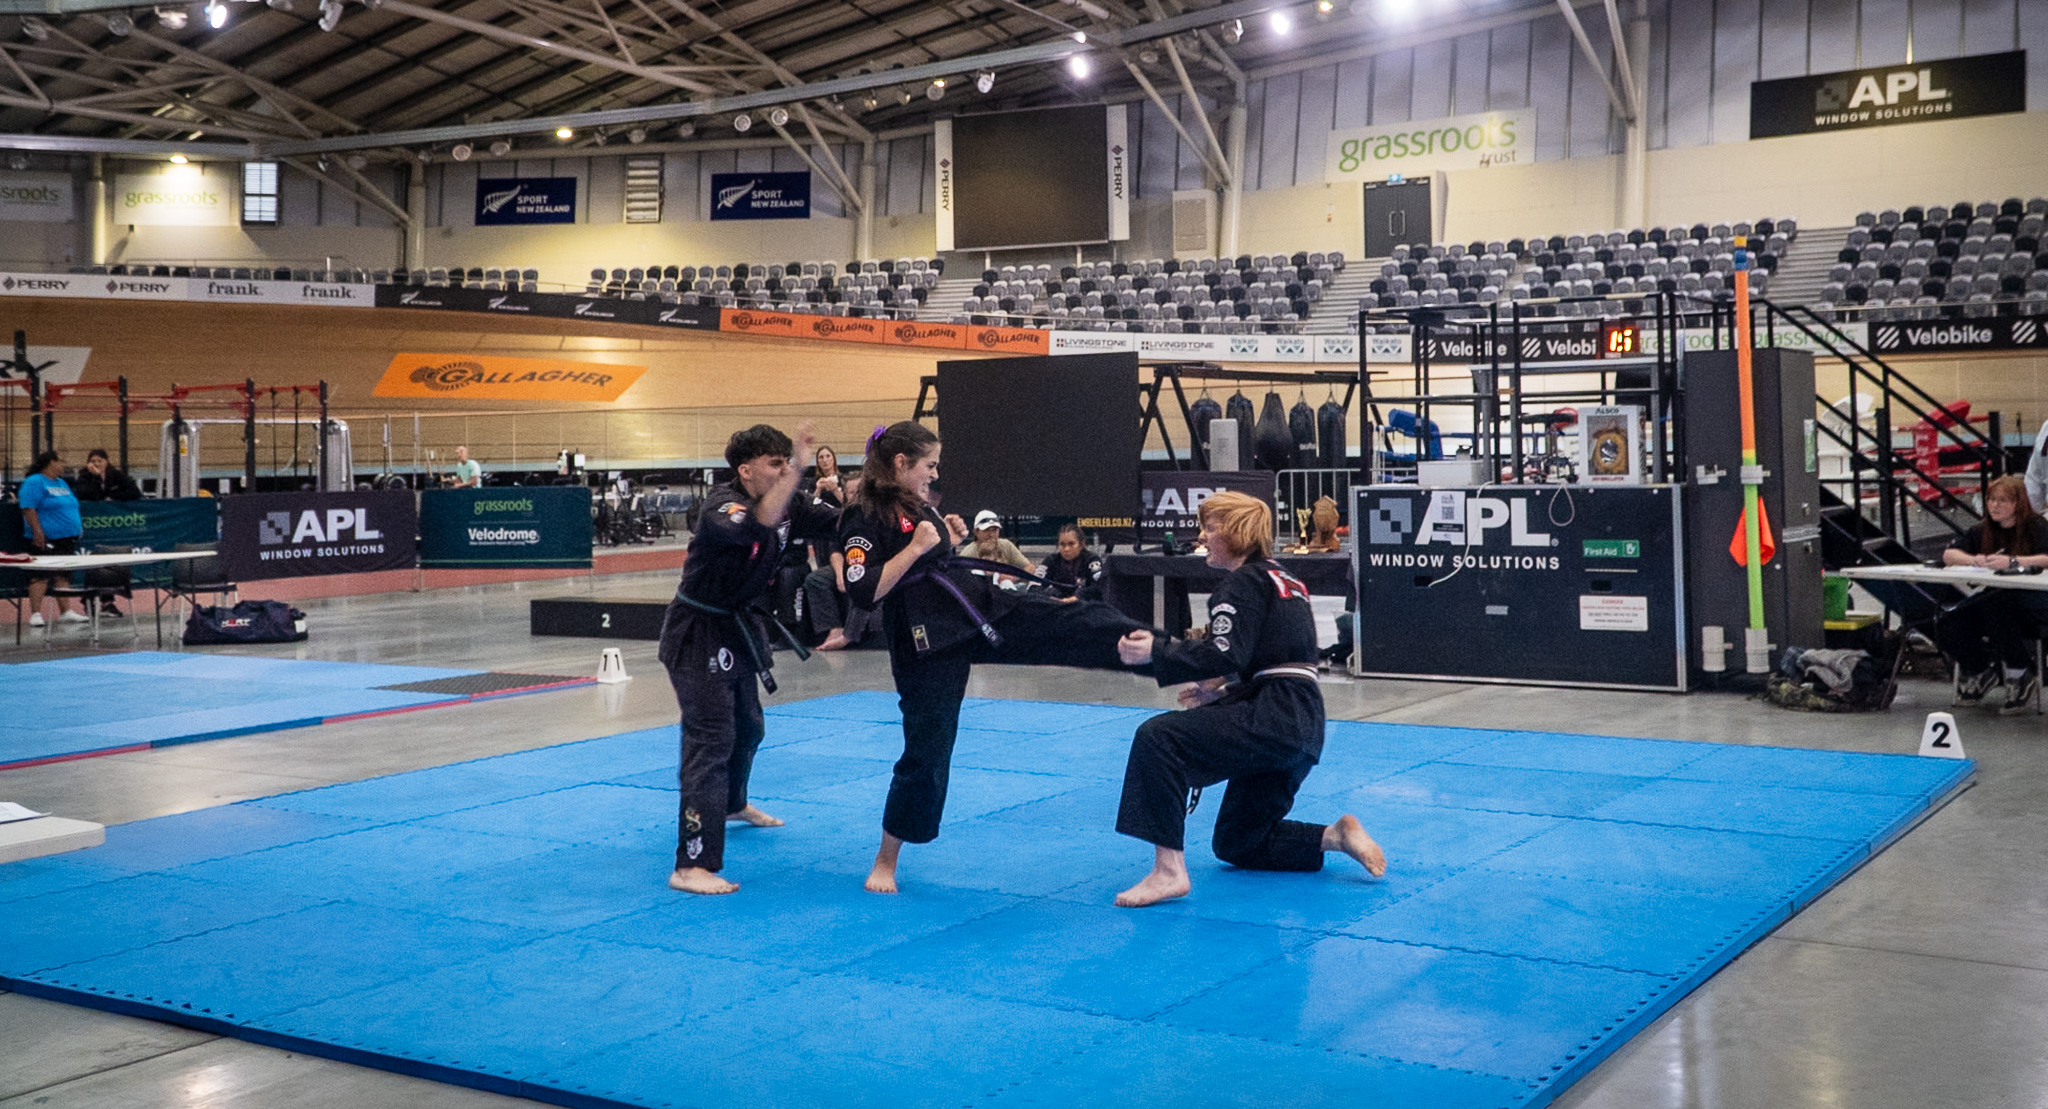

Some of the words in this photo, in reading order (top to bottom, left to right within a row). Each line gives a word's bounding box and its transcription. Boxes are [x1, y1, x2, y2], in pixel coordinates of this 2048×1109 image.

[1848, 68, 1947, 109] APL
[1815, 111, 1870, 126] WINDOW
[1875, 102, 1953, 120] SOLUTIONS
[1338, 117, 1517, 173] grassroots
[1113, 157, 1122, 199] PERRY
[752, 190, 782, 199] SPORT
[941, 170, 950, 211] PERRY
[125, 191, 218, 208] grassroots
[517, 195, 548, 204] SPORT
[751, 200, 768, 208] NEW
[770, 199, 805, 208] ZEALAND
[516, 205, 534, 213] NEW
[535, 205, 570, 213] ZEALAND
[17, 280, 70, 290] PERRY
[120, 283, 170, 293] PERRY
[302, 285, 356, 299] frank.
[741, 316, 793, 327] GALLAGHER
[823, 322, 875, 333] GALLAGHER
[904, 328, 957, 339] GALLAGHER
[987, 333, 1040, 345] GALLAGHER
[1906, 325, 1993, 346] Velobike
[1150, 341, 1215, 349] LIVINGSTONE
[438, 368, 614, 387] GALLAGHER
[474, 498, 534, 516] grassroots
[1155, 487, 1226, 516] AP
[291, 508, 380, 544] APL
[468, 527, 537, 541] Velodrome
[260, 549, 312, 561] WINDOW
[317, 544, 384, 557] SOLUTIONS
[1584, 548, 1603, 556] First
[1603, 548, 1618, 556] Aid
[1370, 554, 1444, 568] WINDOW
[1452, 555, 1560, 570] SOLUTIONS
[602, 613, 611, 628] 2
[1932, 721, 1951, 748] 2
